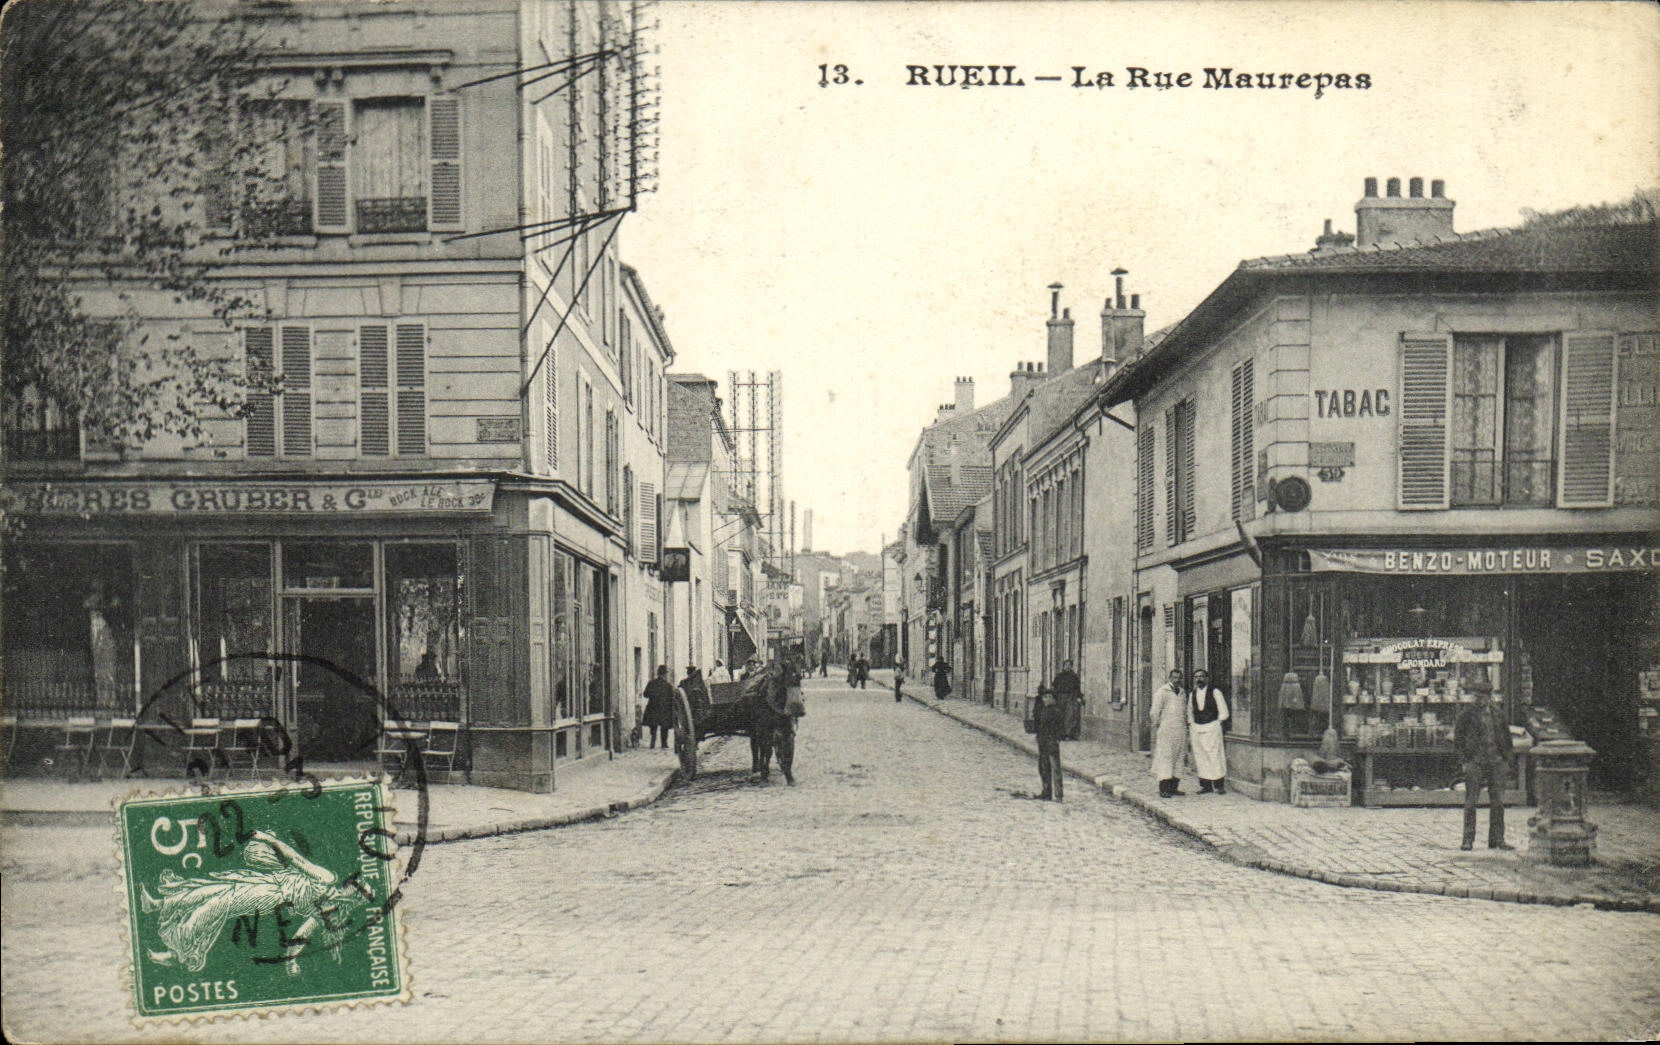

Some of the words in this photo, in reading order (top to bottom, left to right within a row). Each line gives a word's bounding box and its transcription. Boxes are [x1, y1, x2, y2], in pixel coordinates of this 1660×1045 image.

[1314, 389, 1391, 418] TABAC
[171, 489, 313, 511] GRUBER
[322, 494, 337, 512] &
[1385, 550, 1551, 571] BENZO-MOTEUR
[154, 980, 238, 1005] POSTES
